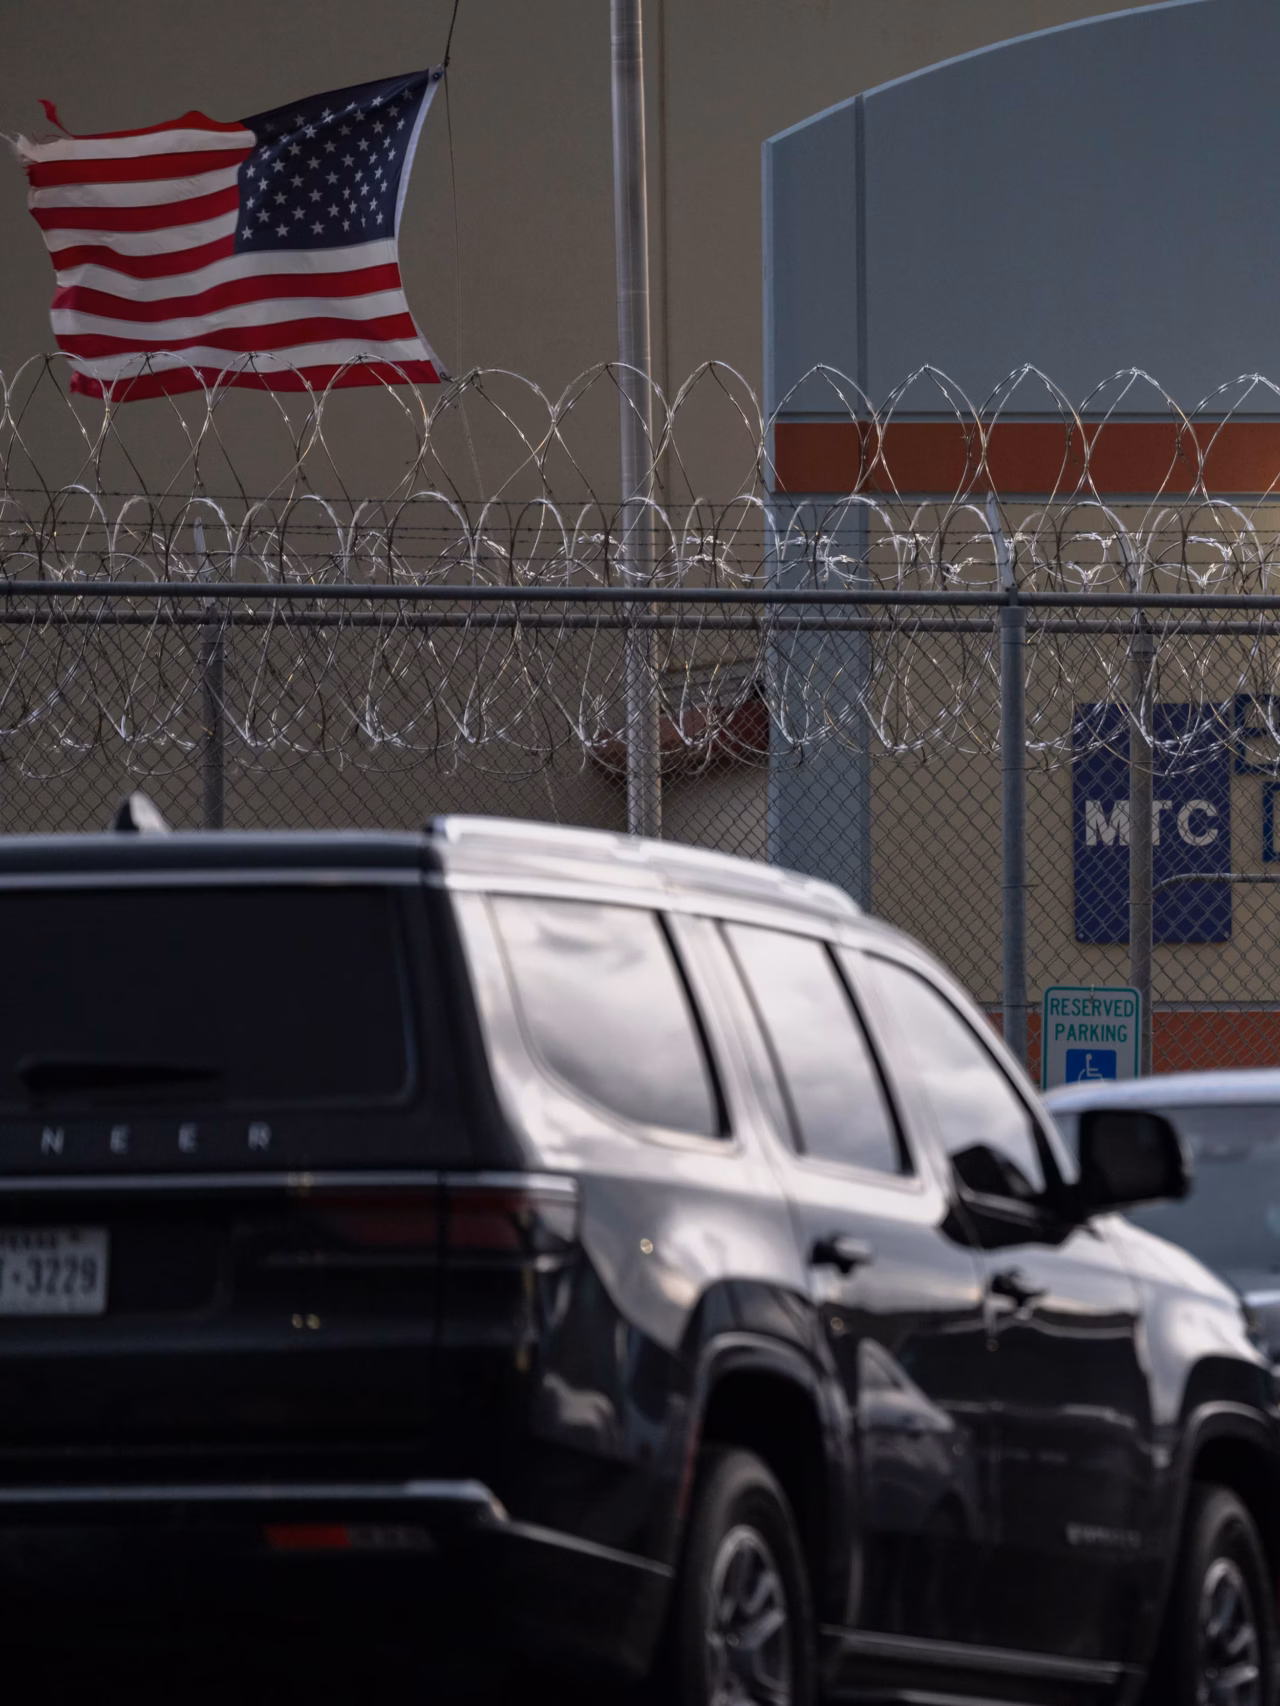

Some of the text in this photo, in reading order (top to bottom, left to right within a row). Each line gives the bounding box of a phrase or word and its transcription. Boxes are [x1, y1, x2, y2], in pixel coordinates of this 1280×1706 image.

[1085, 799, 1218, 846] MTC
[1050, 998, 1135, 1017] RESERVED
[1055, 1023, 1127, 1042] PARKING
